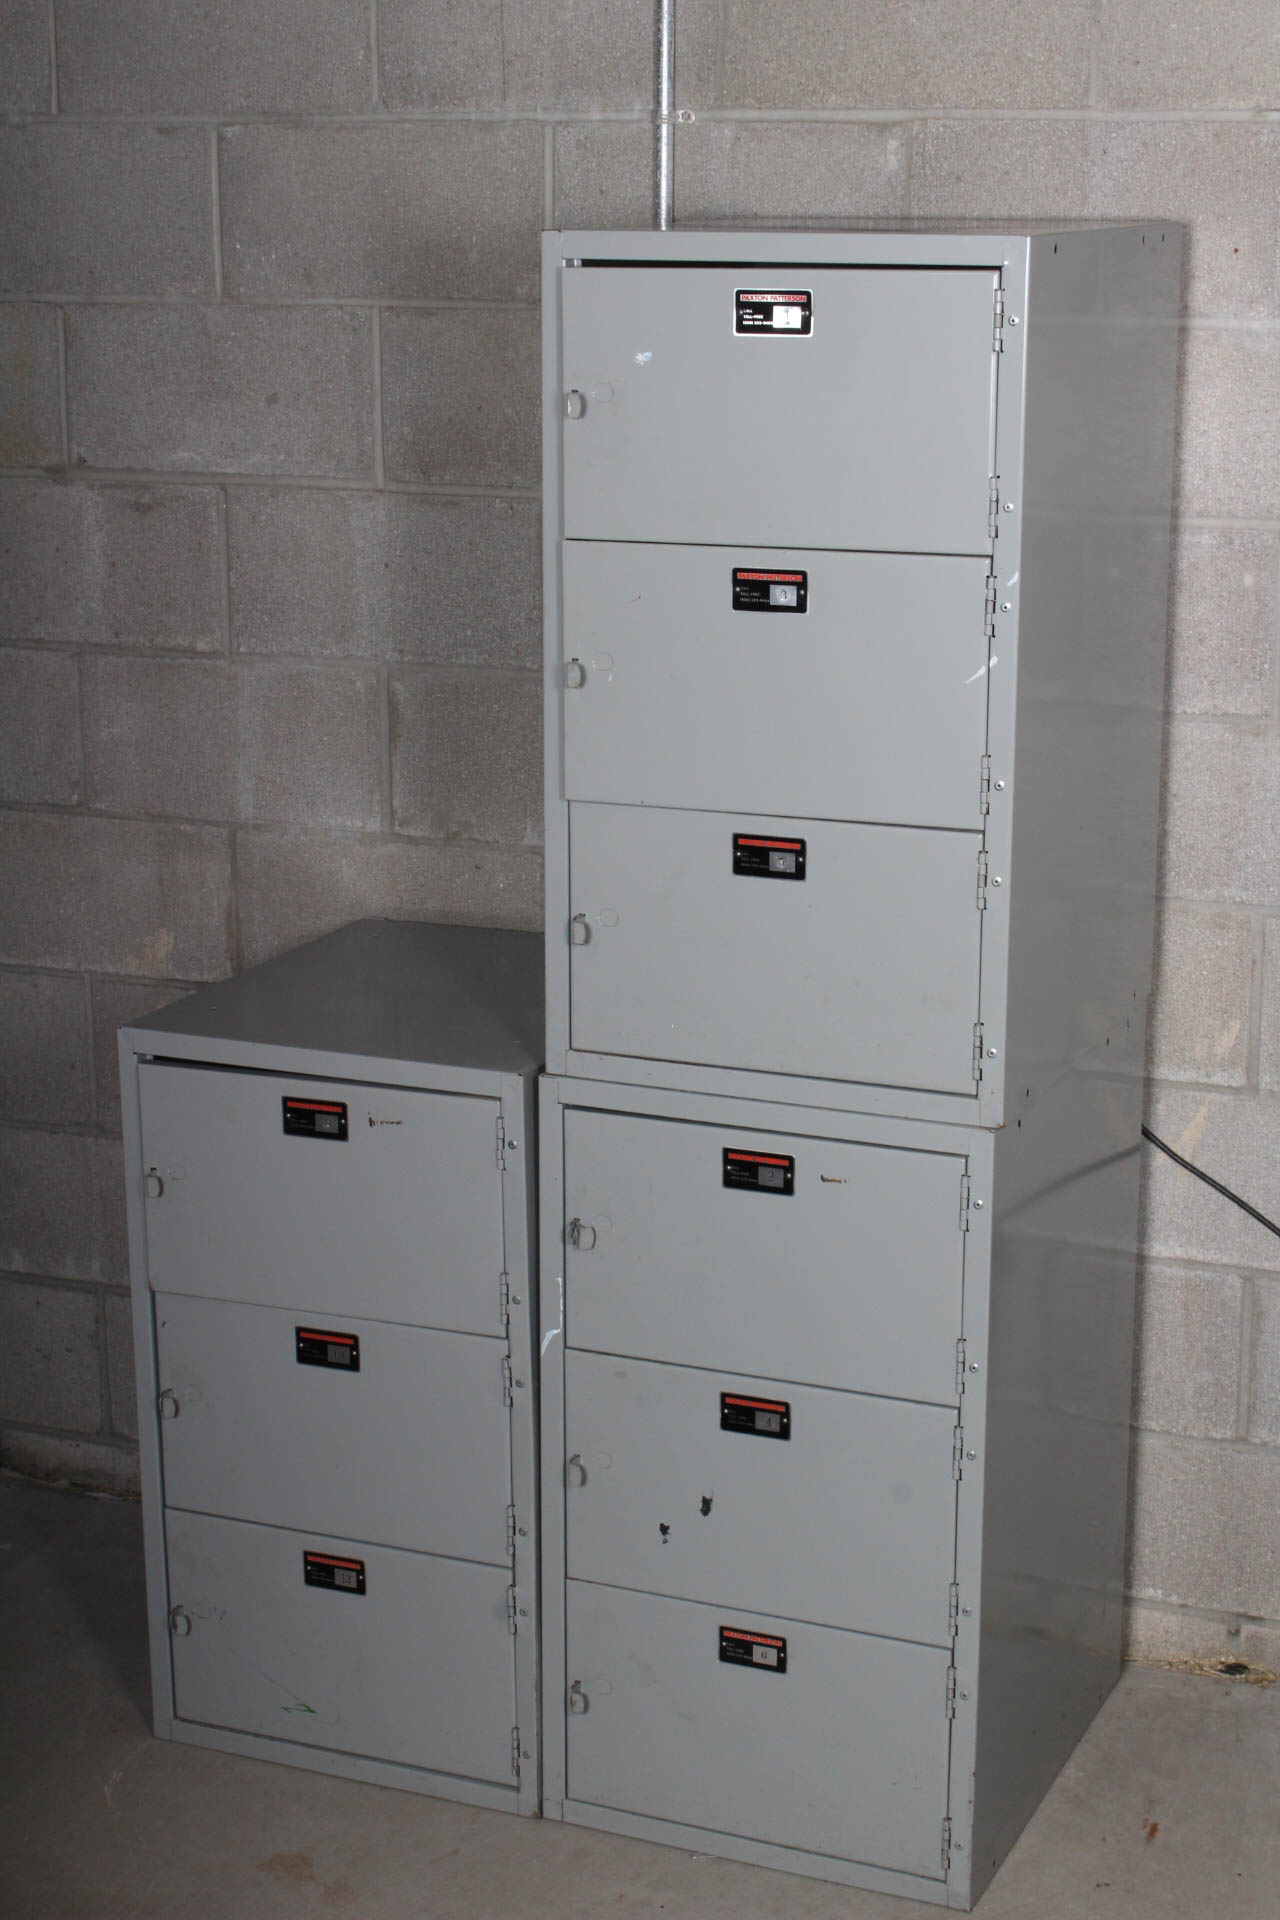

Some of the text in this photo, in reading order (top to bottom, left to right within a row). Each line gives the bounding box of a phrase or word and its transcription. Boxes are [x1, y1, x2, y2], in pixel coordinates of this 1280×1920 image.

[741, 294, 807, 303] PAXTON PATTERSON
[768, 1169, 775, 1183] 2
[342, 1572, 352, 1585] 12
